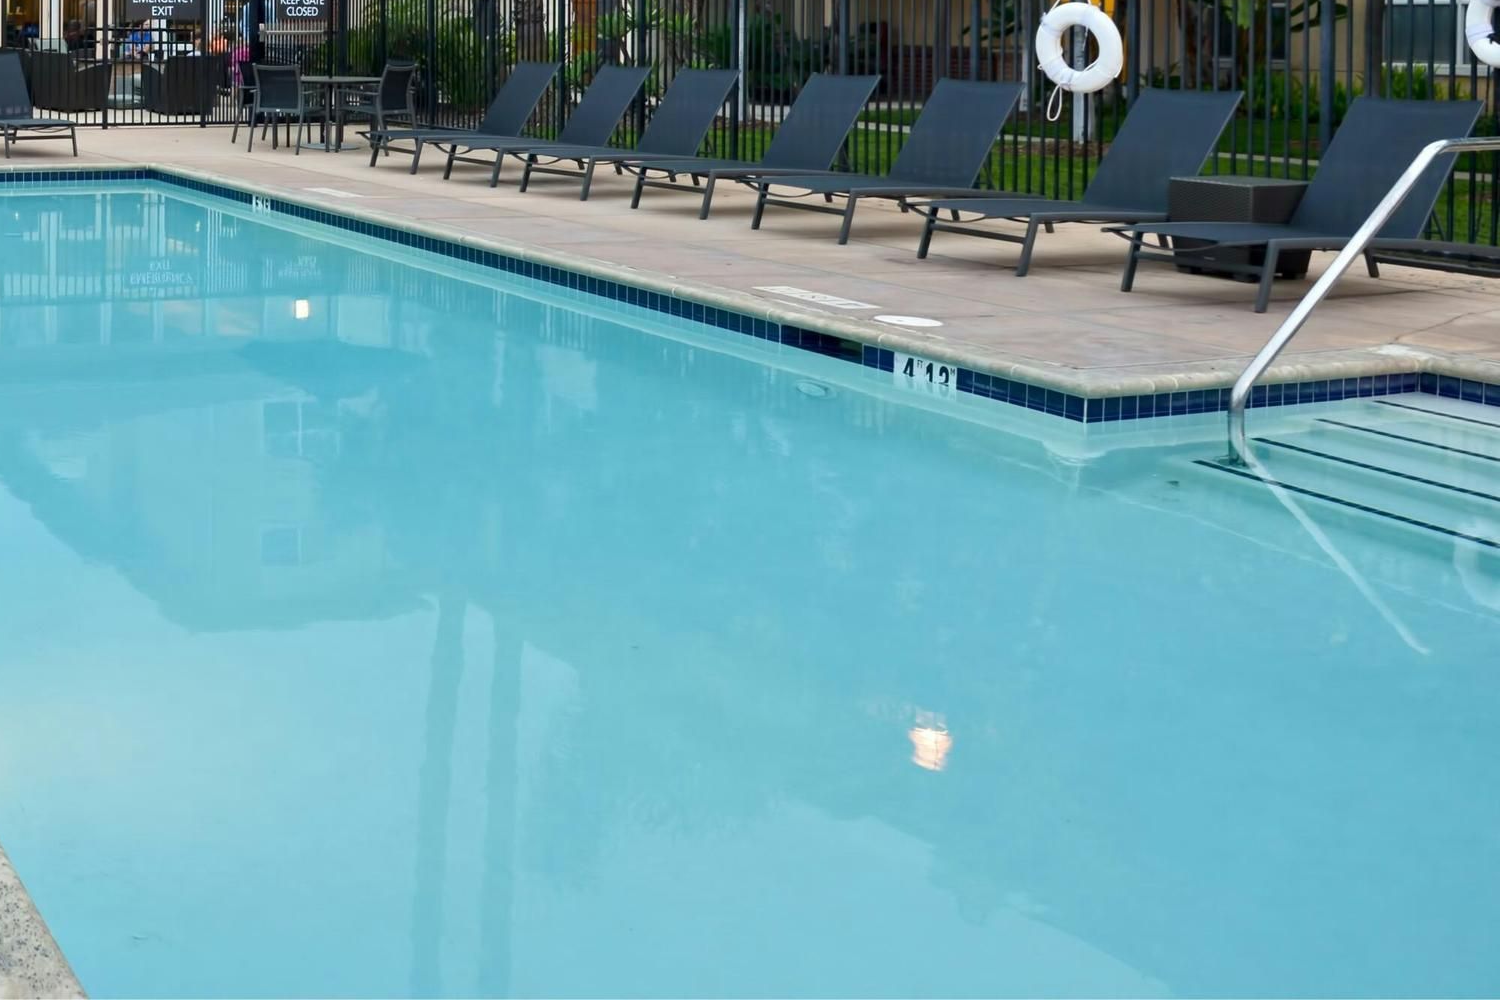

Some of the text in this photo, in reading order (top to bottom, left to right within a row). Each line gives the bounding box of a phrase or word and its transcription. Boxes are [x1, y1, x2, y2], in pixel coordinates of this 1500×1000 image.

[151, 6, 175, 17] EXIT
[286, 6, 319, 17] CLOSED
[903, 357, 915, 377] 4
